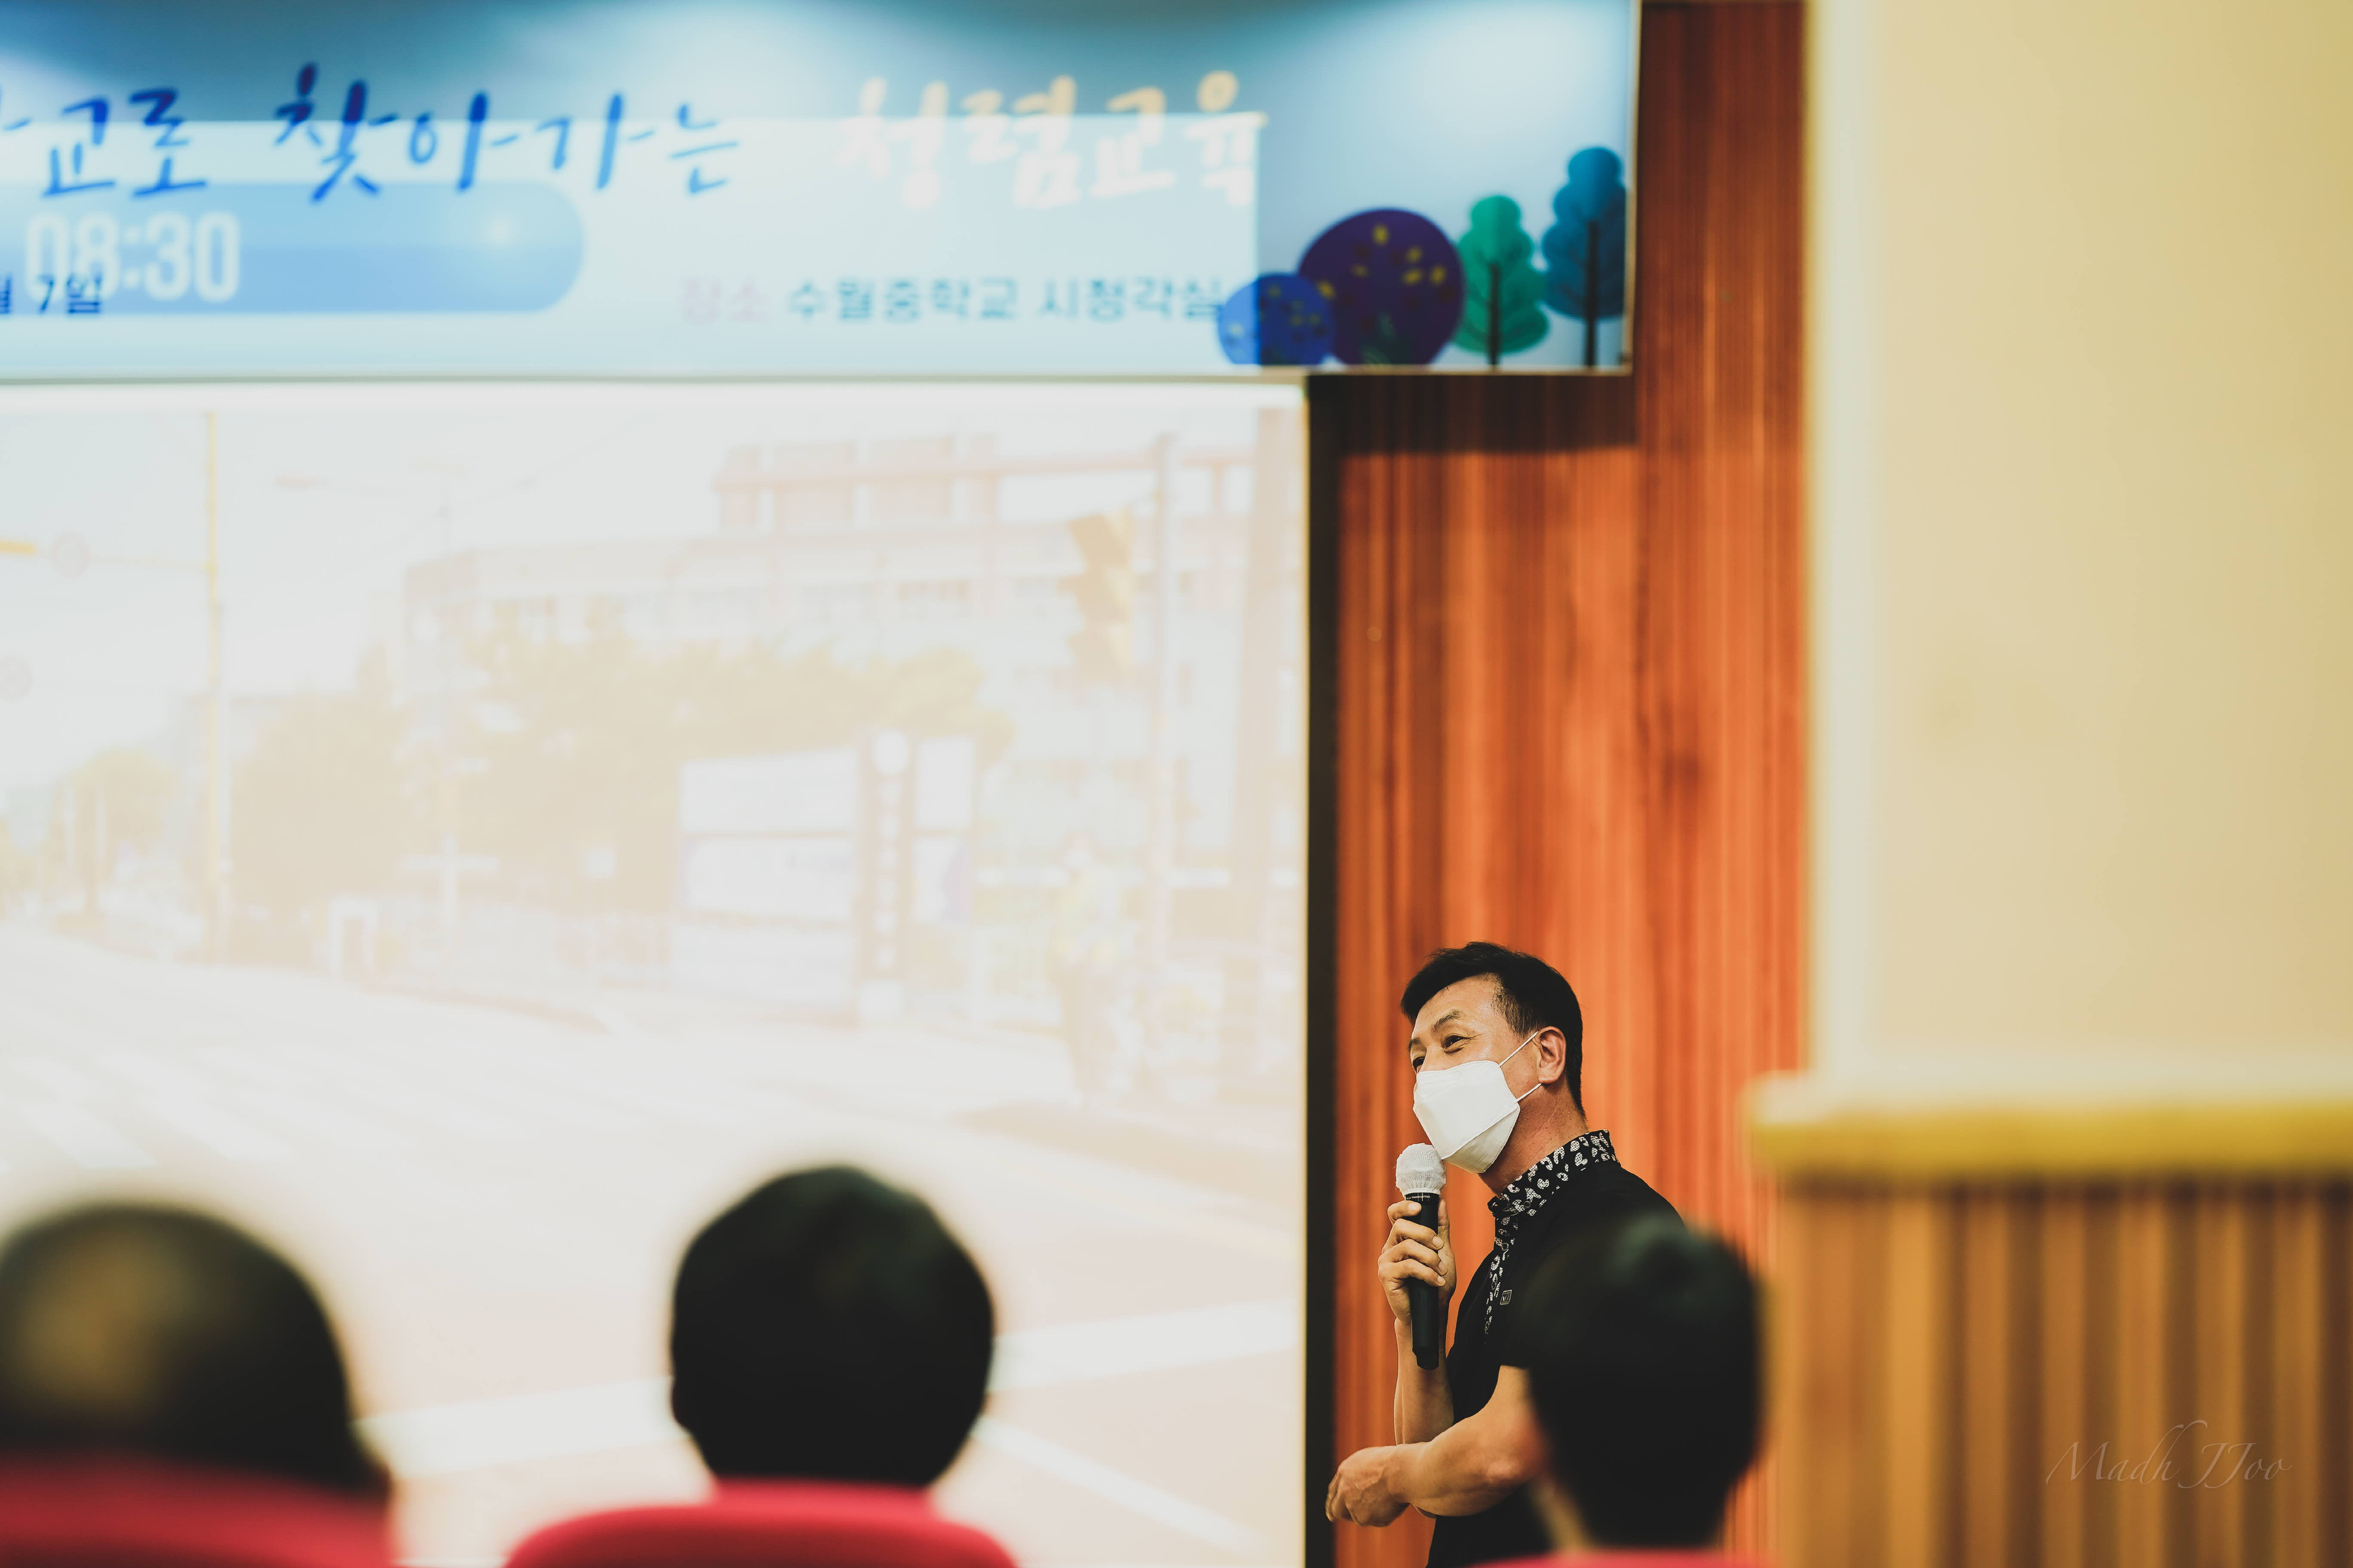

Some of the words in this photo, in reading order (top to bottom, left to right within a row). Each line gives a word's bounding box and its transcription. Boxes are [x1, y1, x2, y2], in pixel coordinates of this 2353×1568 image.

[0, 87, 206, 200] 교로
[274, 62, 739, 203] 찾아가는
[836, 71, 1267, 208] 청렴교육
[26, 212, 239, 302] 08:30
[788, 279, 1017, 323] 수월중학교
[1038, 279, 1224, 322] 시청각실
